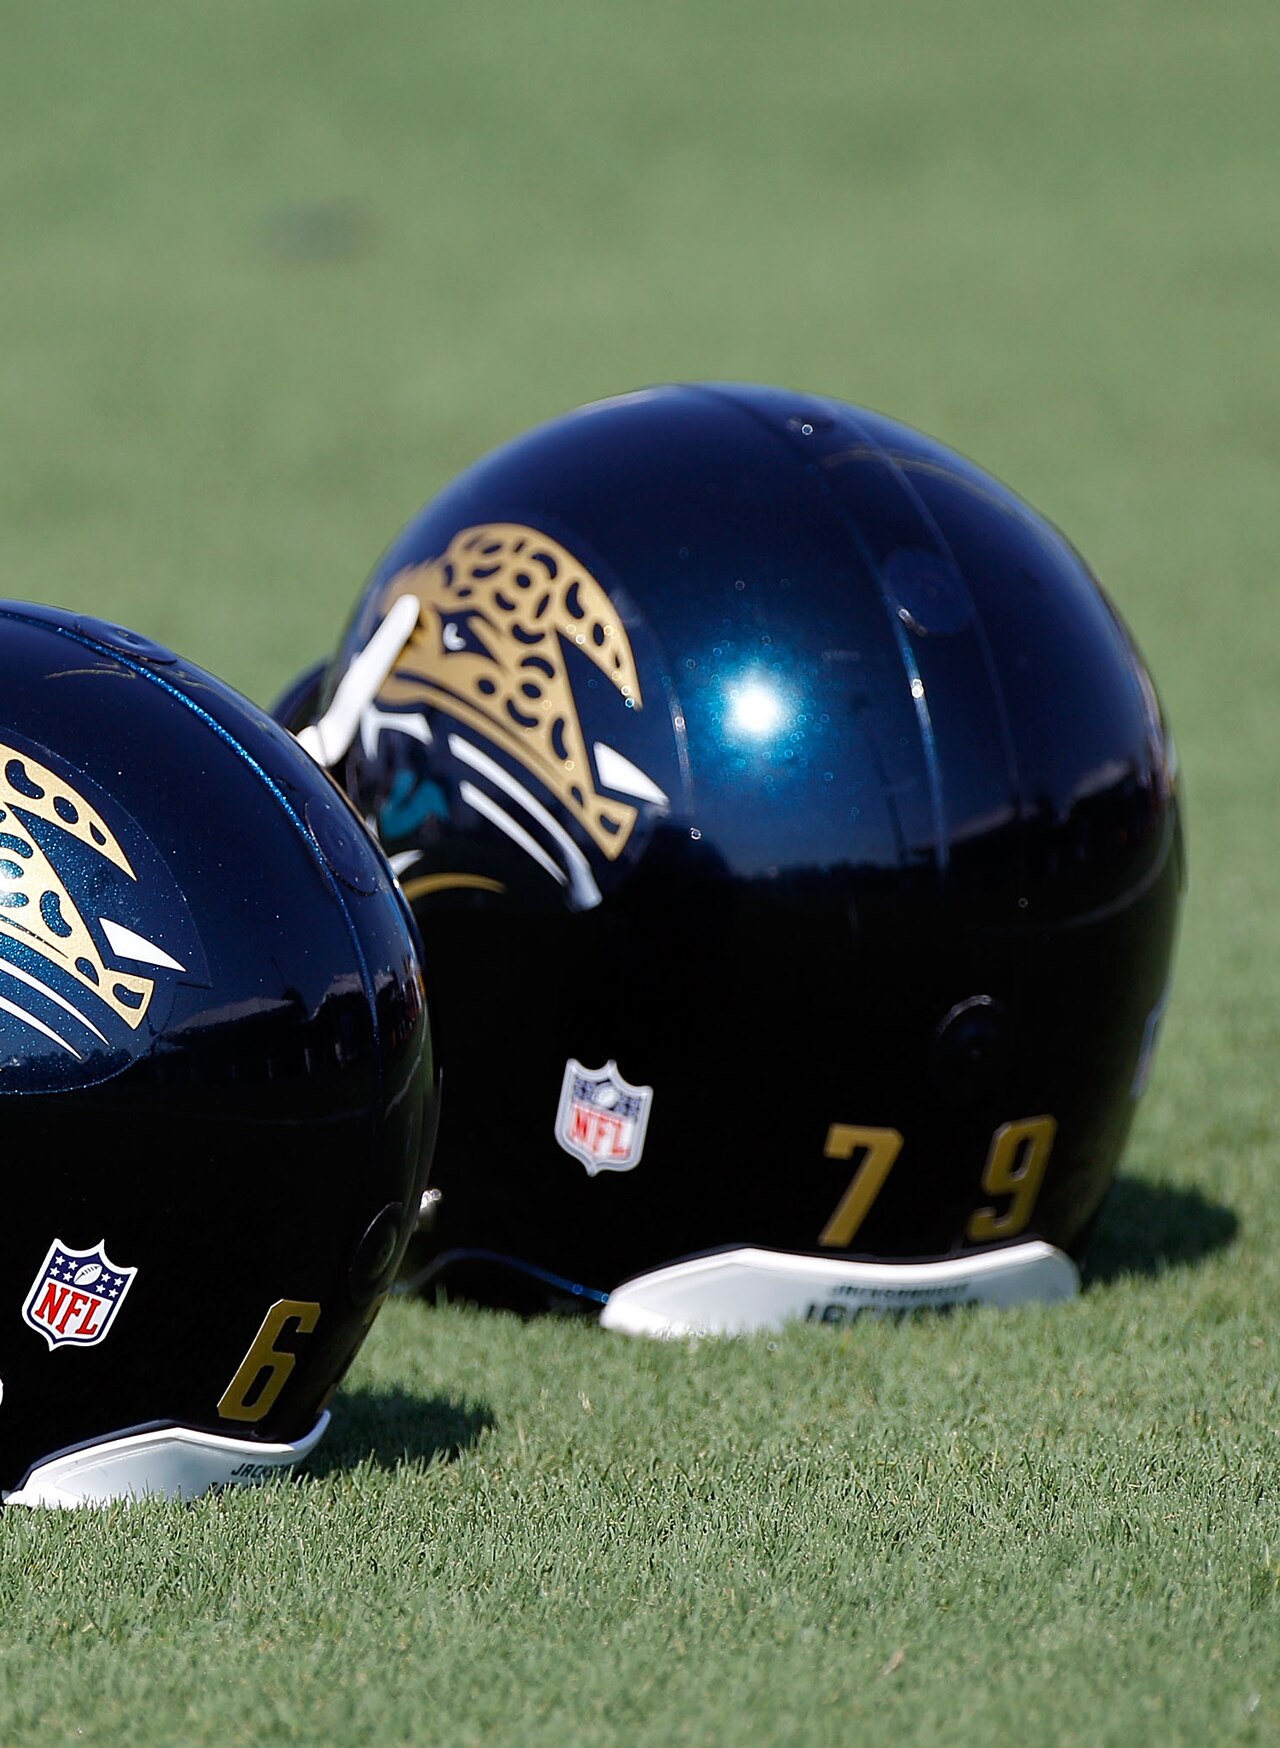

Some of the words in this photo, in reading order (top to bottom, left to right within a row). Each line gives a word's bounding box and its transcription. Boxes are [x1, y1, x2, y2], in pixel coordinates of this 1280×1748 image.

[570, 1104, 631, 1159] NFL
[819, 1123, 904, 1247] 7
[969, 1115, 1057, 1242] 9
[34, 1283, 102, 1335] NFL
[217, 1299, 321, 1422] 6
